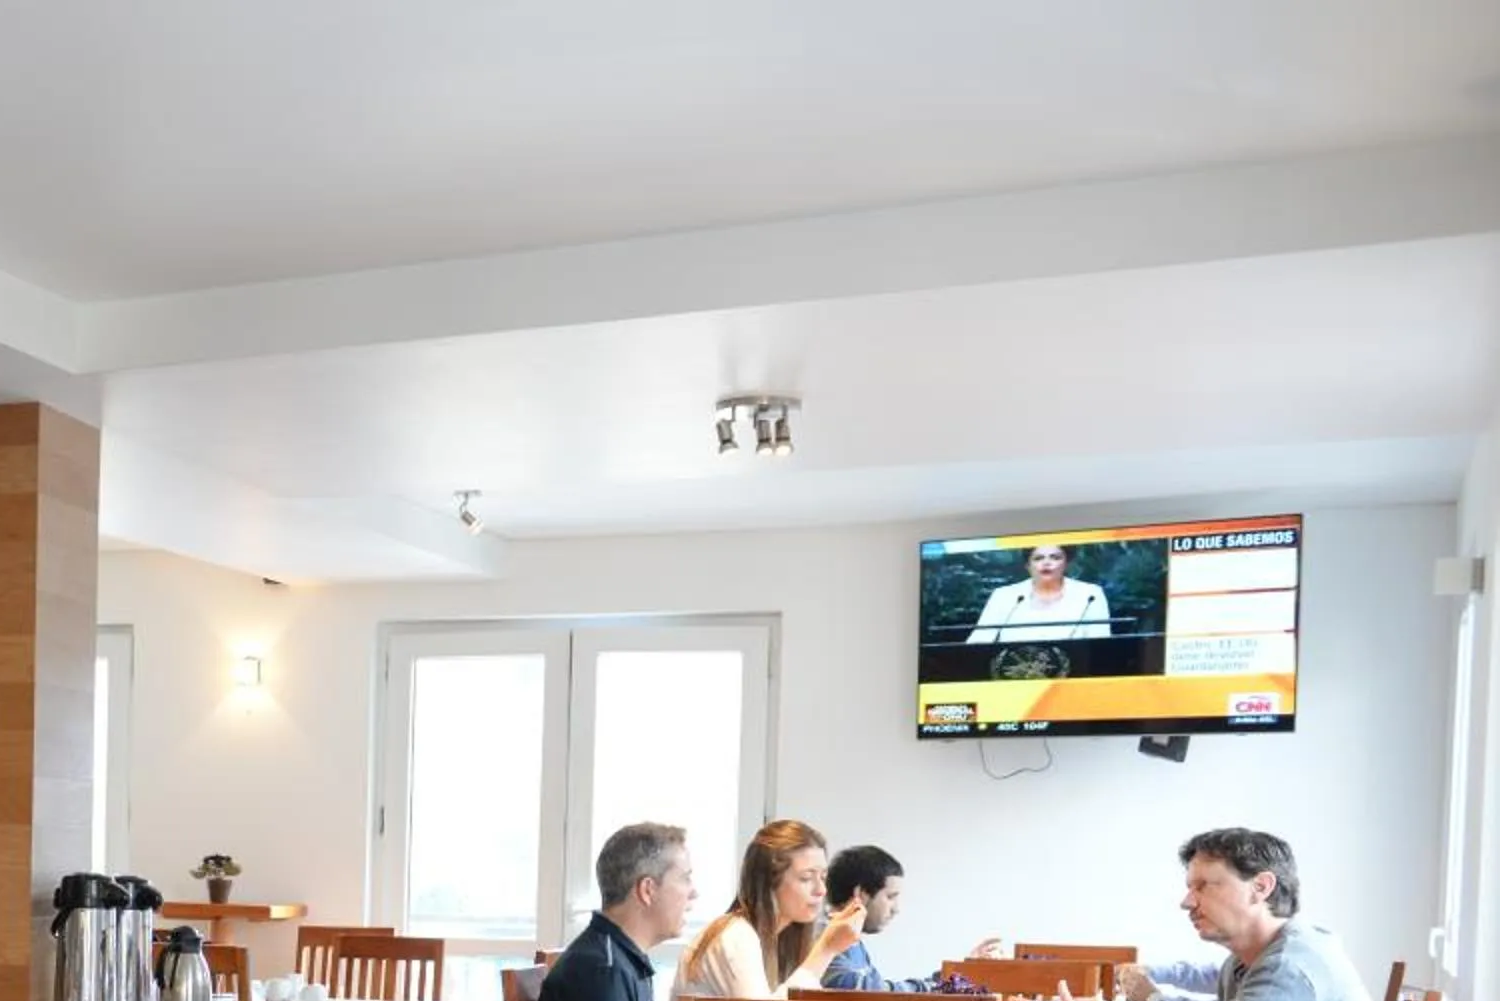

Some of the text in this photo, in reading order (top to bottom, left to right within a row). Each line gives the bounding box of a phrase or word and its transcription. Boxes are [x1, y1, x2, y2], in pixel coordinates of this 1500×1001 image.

[1174, 531, 1295, 551] LO QUE SABEMOS
[1235, 700, 1271, 713] CNN
